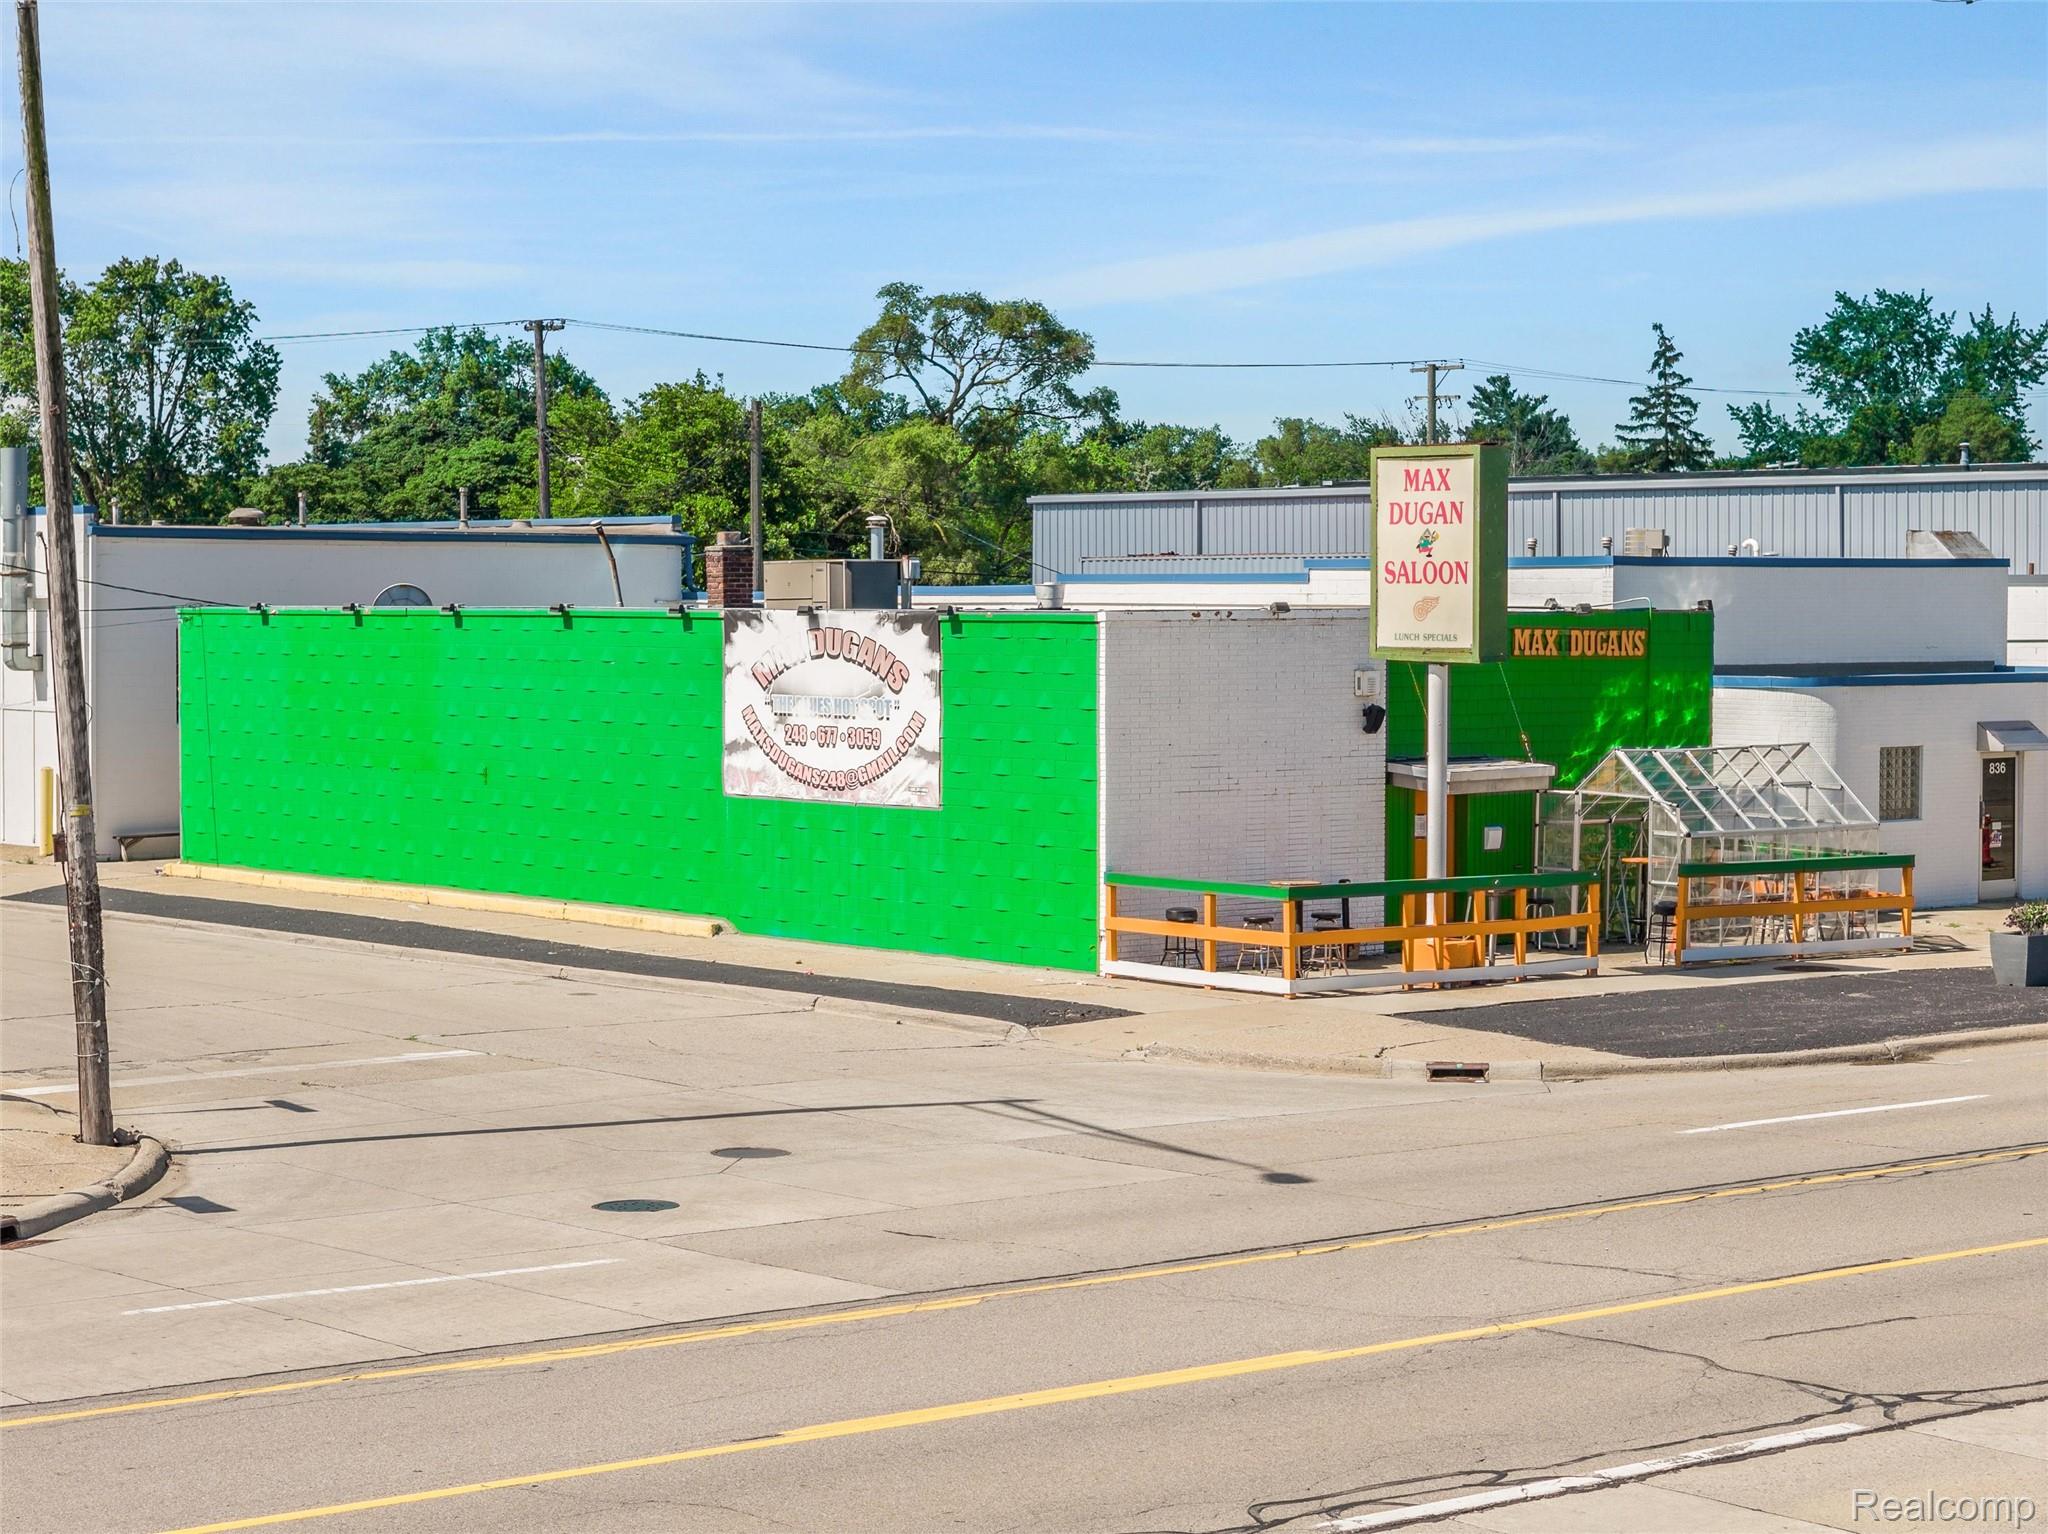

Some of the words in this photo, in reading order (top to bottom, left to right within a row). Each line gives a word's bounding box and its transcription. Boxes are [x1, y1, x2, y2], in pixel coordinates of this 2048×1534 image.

[1403, 468, 1451, 492] MAX
[1389, 501, 1464, 525] DUGAN
[1384, 560, 1469, 585] SALOON
[1394, 632, 1420, 642] LUNCH
[1422, 633, 1458, 643] SPECIALS
[1513, 628, 1559, 656] MAX
[1570, 629, 1646, 656] DUGANS
[806, 626, 911, 694] DUGANS
[784, 723, 808, 747] 248
[816, 725, 838, 748] 677
[847, 727, 881, 750] 3059
[1988, 762, 2007, 775] 836
